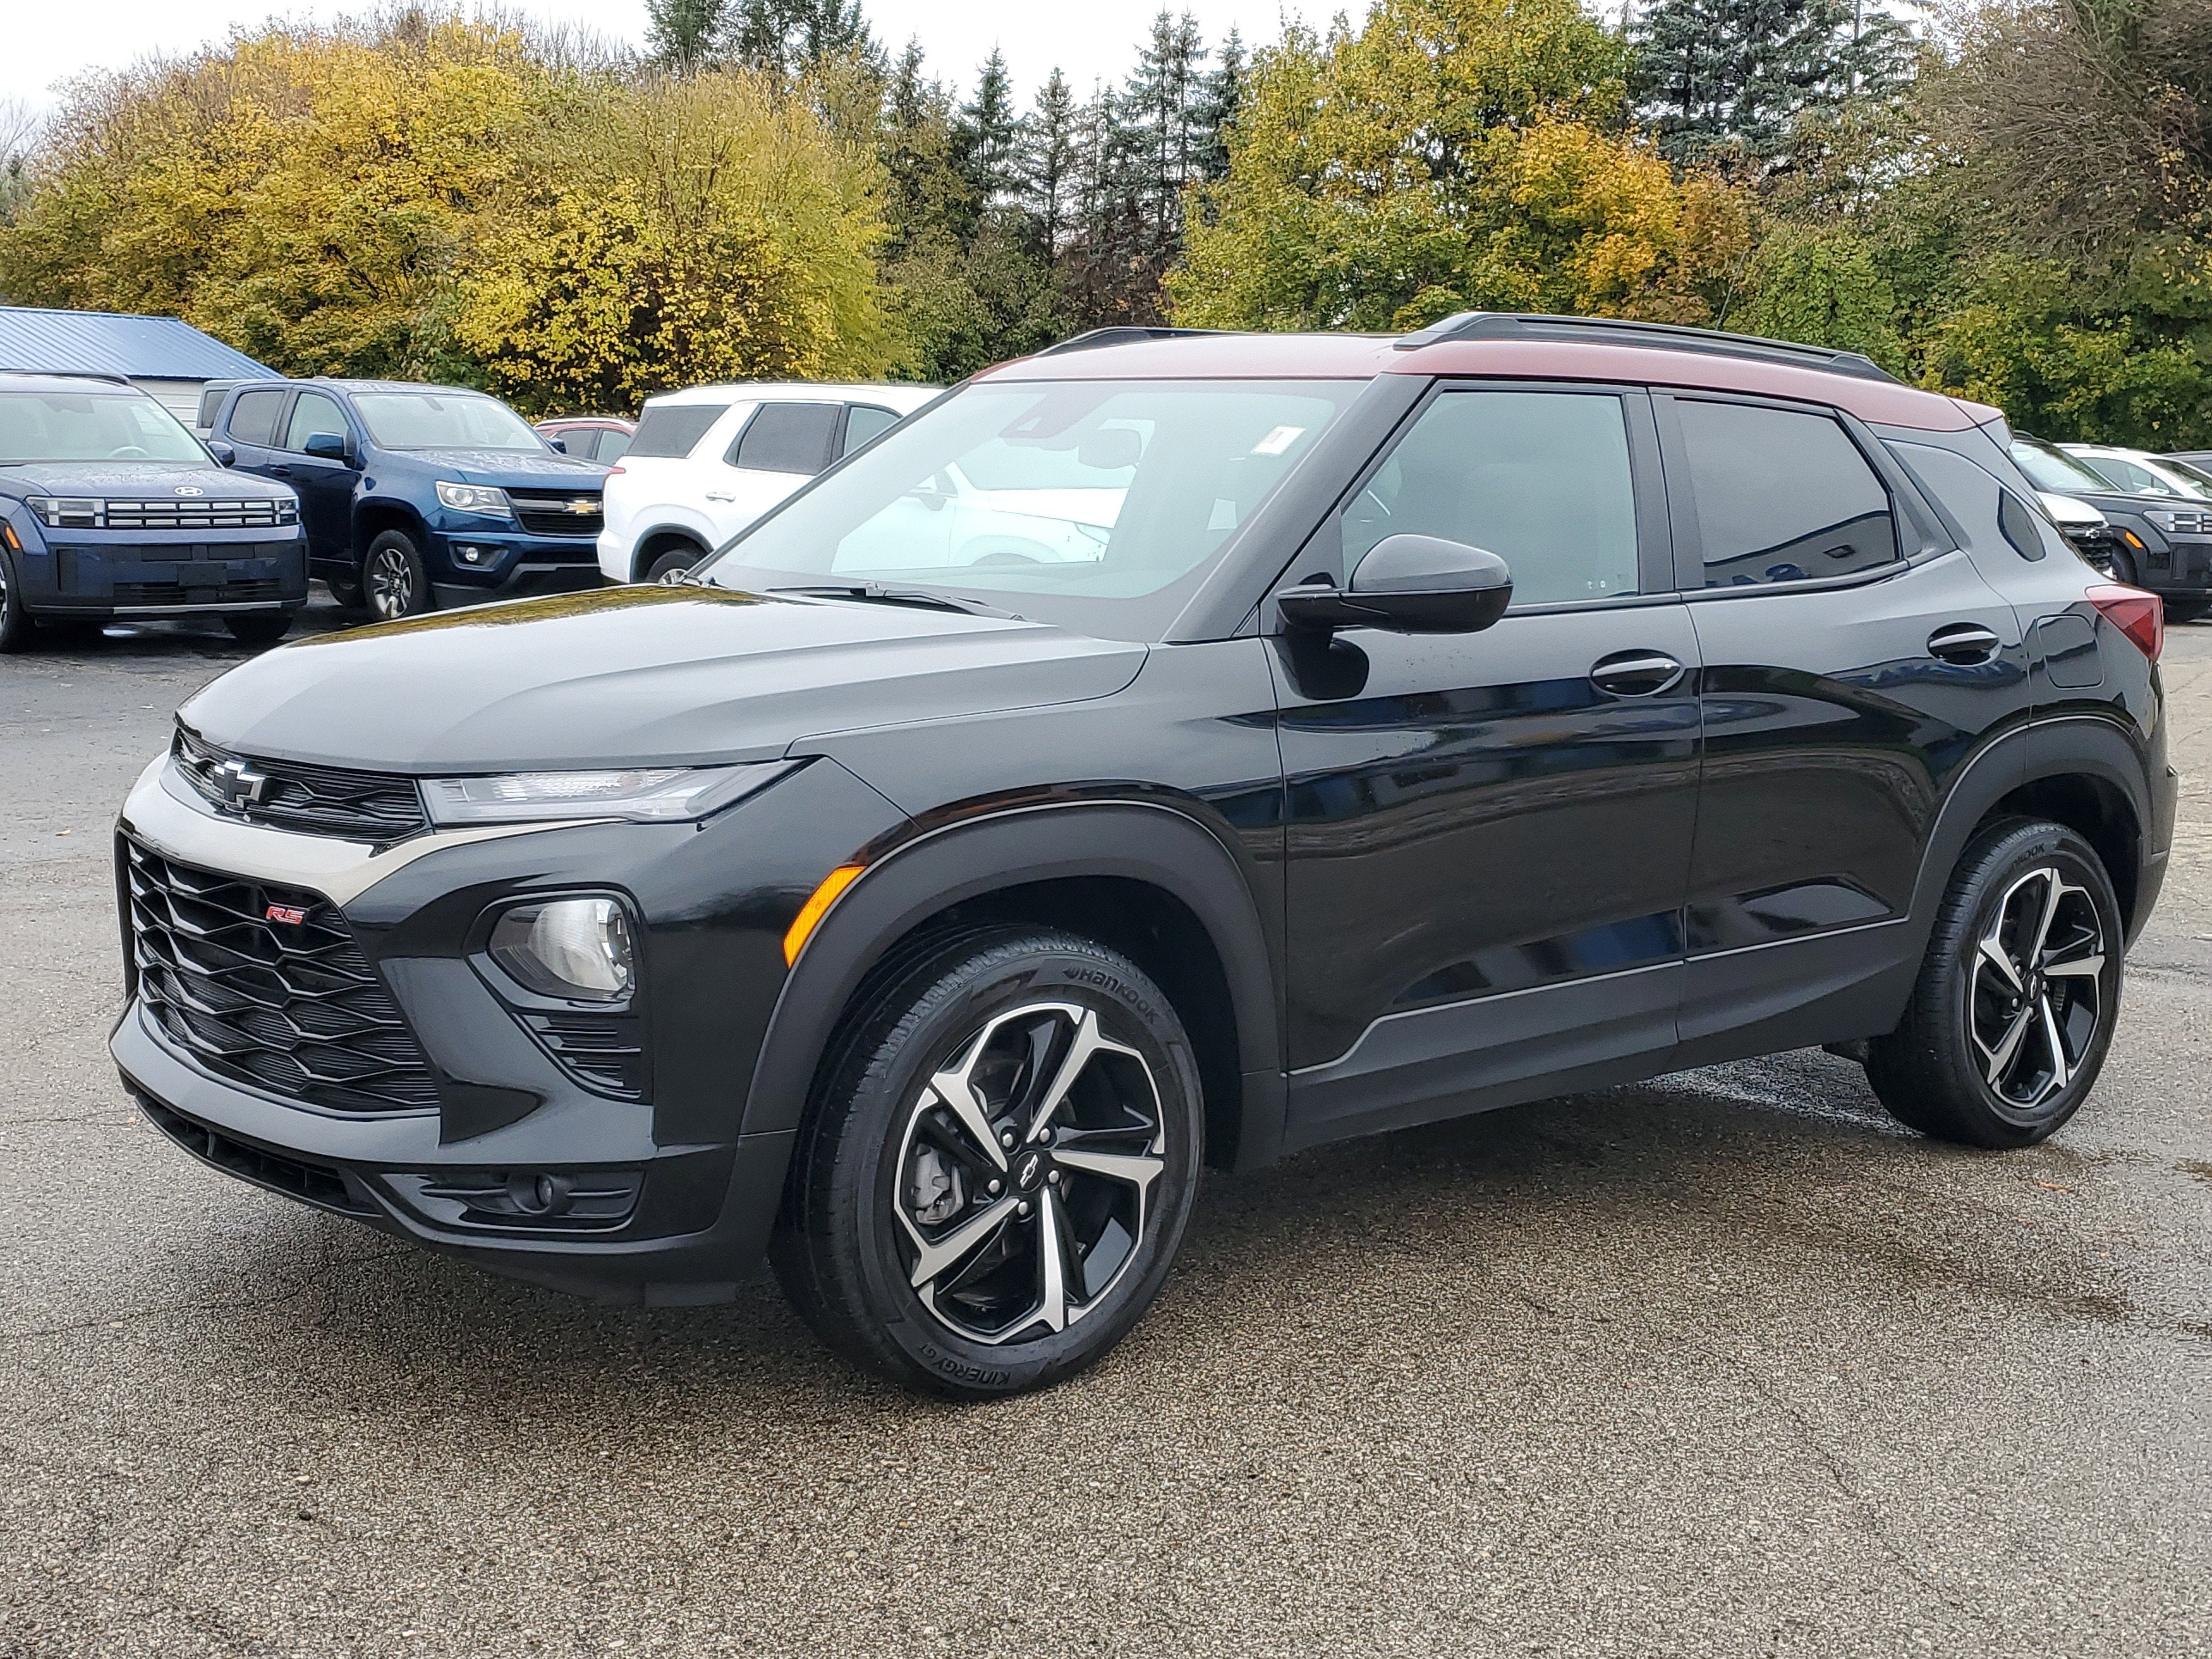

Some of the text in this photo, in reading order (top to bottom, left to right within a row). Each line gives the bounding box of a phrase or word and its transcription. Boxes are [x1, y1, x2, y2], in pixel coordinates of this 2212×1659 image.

[266, 906, 305, 924] RS
[919, 1344, 1011, 1385] KINERGY GT
